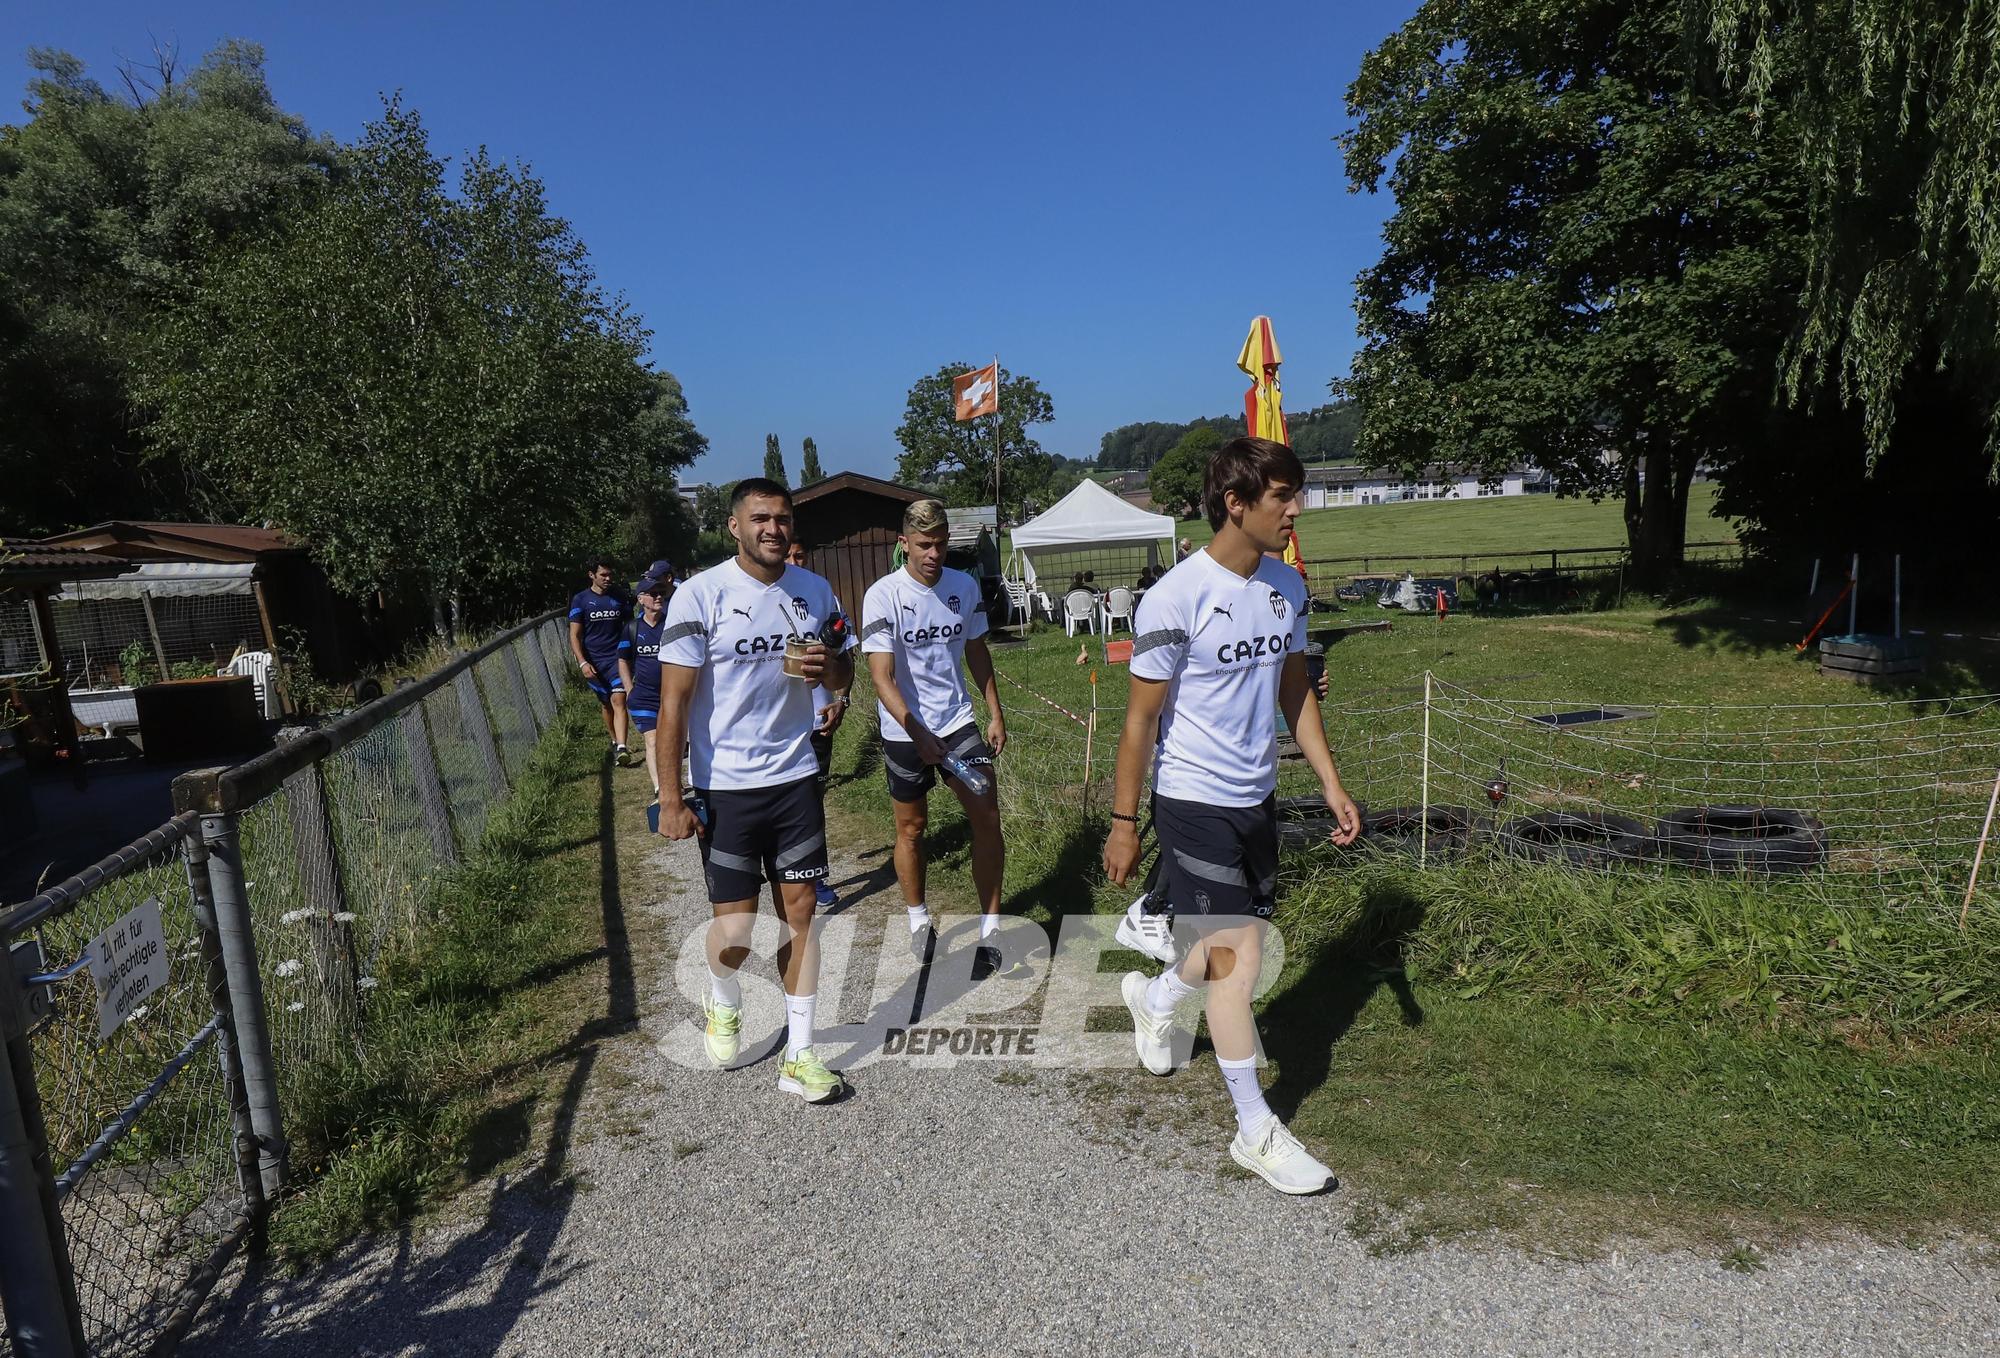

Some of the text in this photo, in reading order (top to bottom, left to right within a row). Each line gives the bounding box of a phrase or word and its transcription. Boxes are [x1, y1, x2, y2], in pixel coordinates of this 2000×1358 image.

[590, 610, 620, 619] CAZOO
[904, 623, 963, 643] CAZOO
[637, 645, 660, 654] CAZ
[1217, 633, 1292, 664] CAZOO
[129, 919, 143, 940] für
